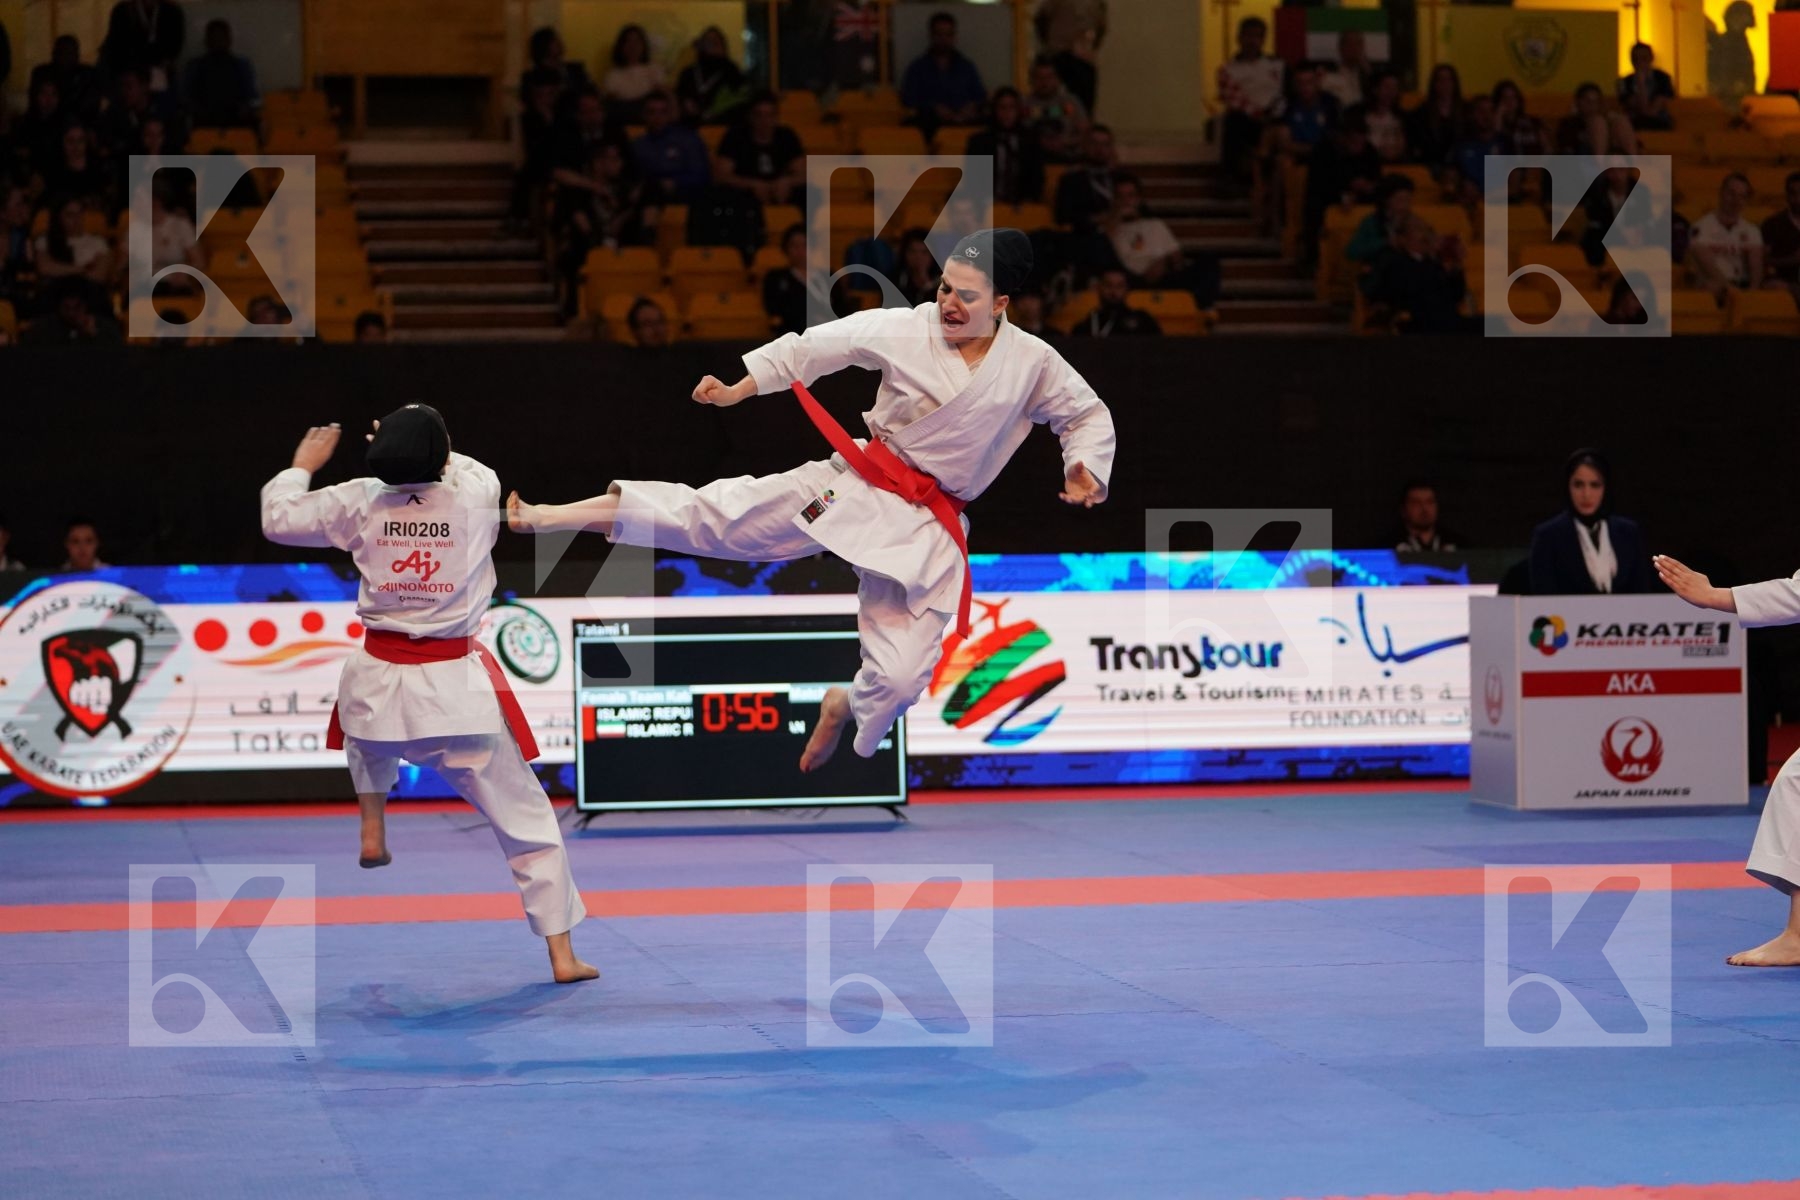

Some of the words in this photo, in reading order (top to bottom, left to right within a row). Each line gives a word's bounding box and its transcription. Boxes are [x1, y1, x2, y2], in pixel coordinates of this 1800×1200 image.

[384, 521, 450, 538] IRI0208
[377, 539, 389, 547] Eat
[391, 540, 413, 548] Well,
[414, 540, 433, 548] Live
[377, 582, 455, 593] AJINOMOTO
[575, 623, 620, 637] Tatami
[621, 623, 630, 636] 1
[1577, 622, 1715, 638] KARATE
[1717, 621, 1731, 644] 1
[1574, 638, 1646, 648] PREMIER
[1651, 637, 1715, 647] LEAGUE
[1089, 636, 1284, 678] Transtour
[1096, 684, 1165, 702] Travel
[1172, 684, 1188, 701] &
[1195, 682, 1286, 701] Tourism
[1606, 673, 1656, 693] AKA
[1287, 685, 1424, 704] EMIRATES
[597, 707, 651, 721] ISLAMIC
[702, 692, 779, 732] 0:56
[1289, 708, 1426, 728] FOUNDATION
[626, 723, 681, 738] ISLAMIC
[231, 730, 327, 752] Taka
[2, 720, 31, 752] UAE
[28, 750, 84, 785] KARATE
[90, 722, 178, 787] FEDERATION
[1617, 763, 1651, 776] JAL
[1574, 788, 1621, 799] JAPAN
[1623, 787, 1691, 797] AIRLINES
